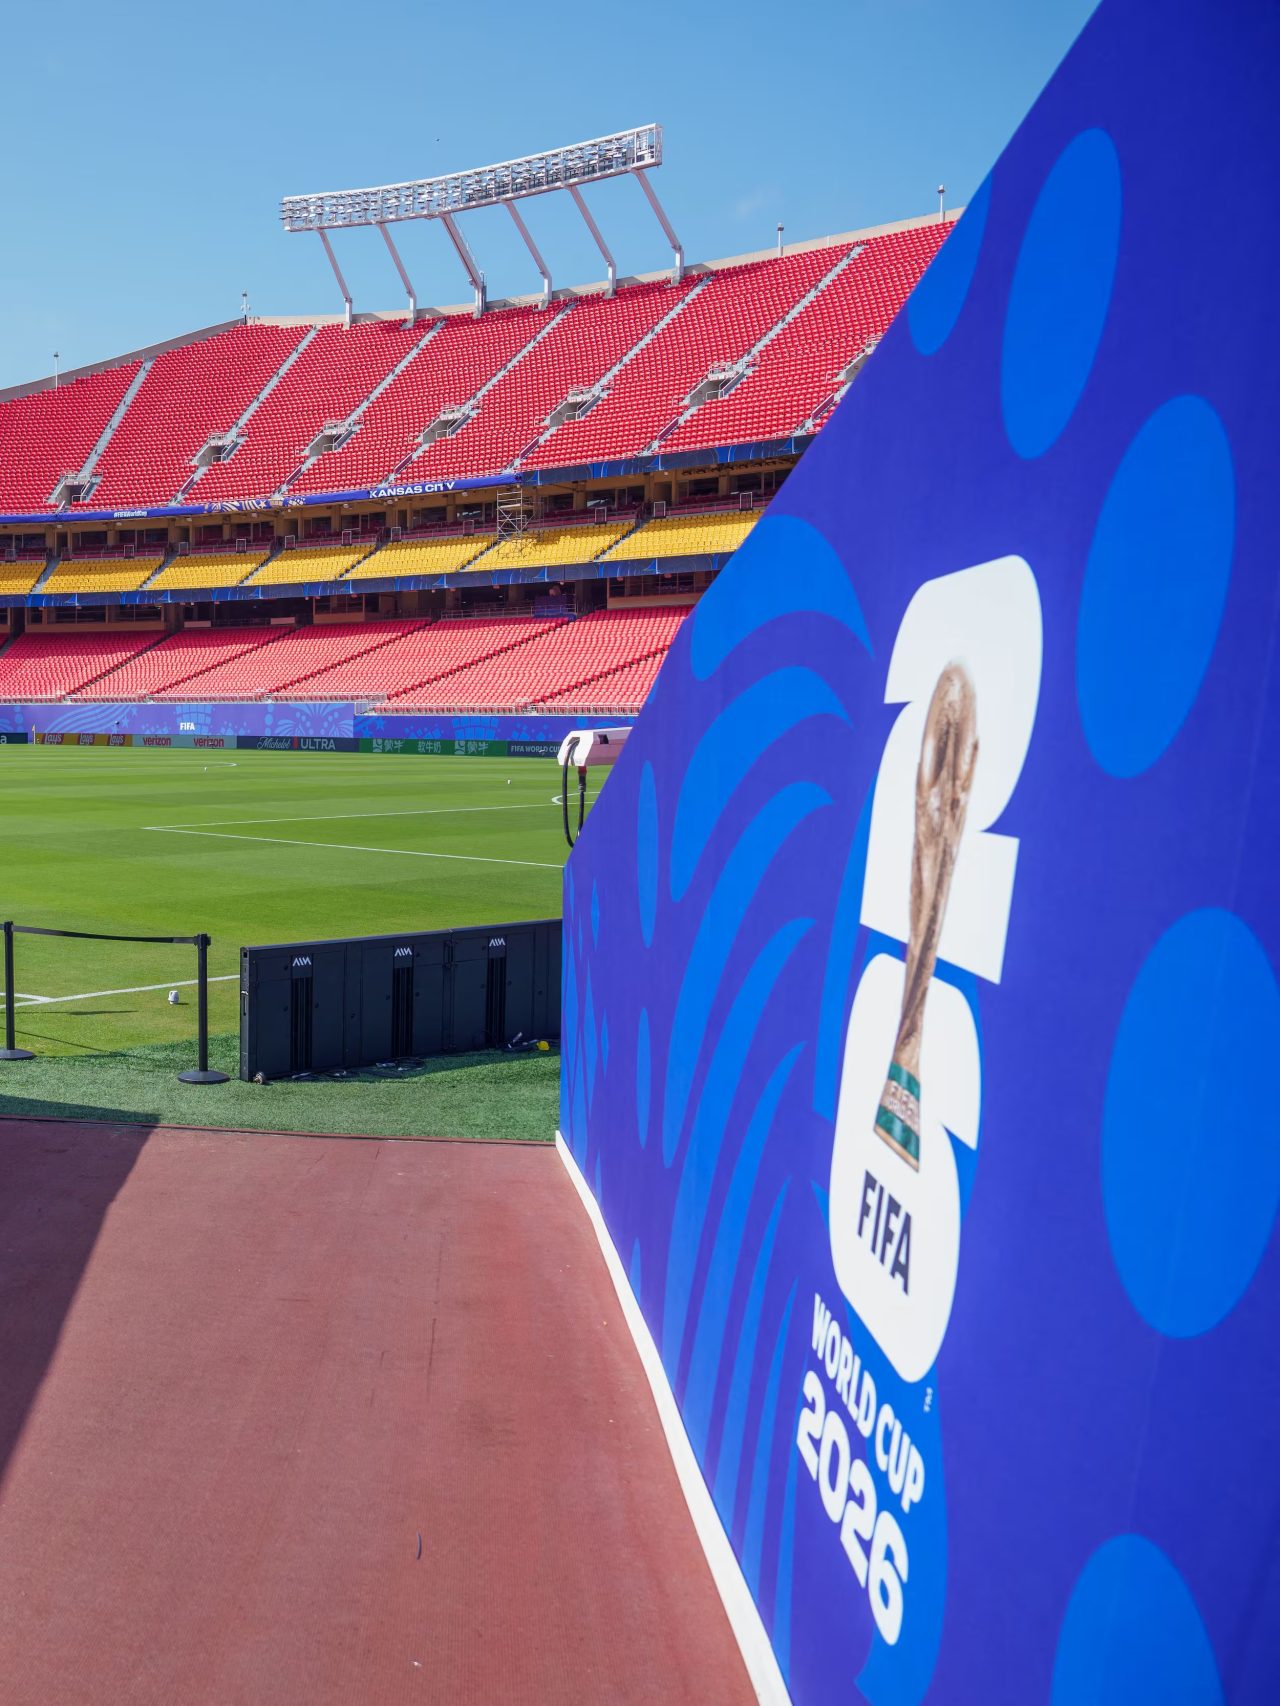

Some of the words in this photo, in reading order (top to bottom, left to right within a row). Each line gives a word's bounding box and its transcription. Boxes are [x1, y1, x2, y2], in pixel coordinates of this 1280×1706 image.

[370, 485, 423, 499] KANSAS
[425, 481, 456, 491] CITY
[180, 722, 195, 731] FIFA
[142, 735, 172, 746] verizon
[193, 736, 225, 748] verizon
[300, 738, 336, 750] ULTRA
[857, 1169, 911, 1296] FIFA
[812, 1292, 878, 1439] WORLD
[875, 1403, 926, 1515] CUP
[796, 1370, 909, 1647] 2026
